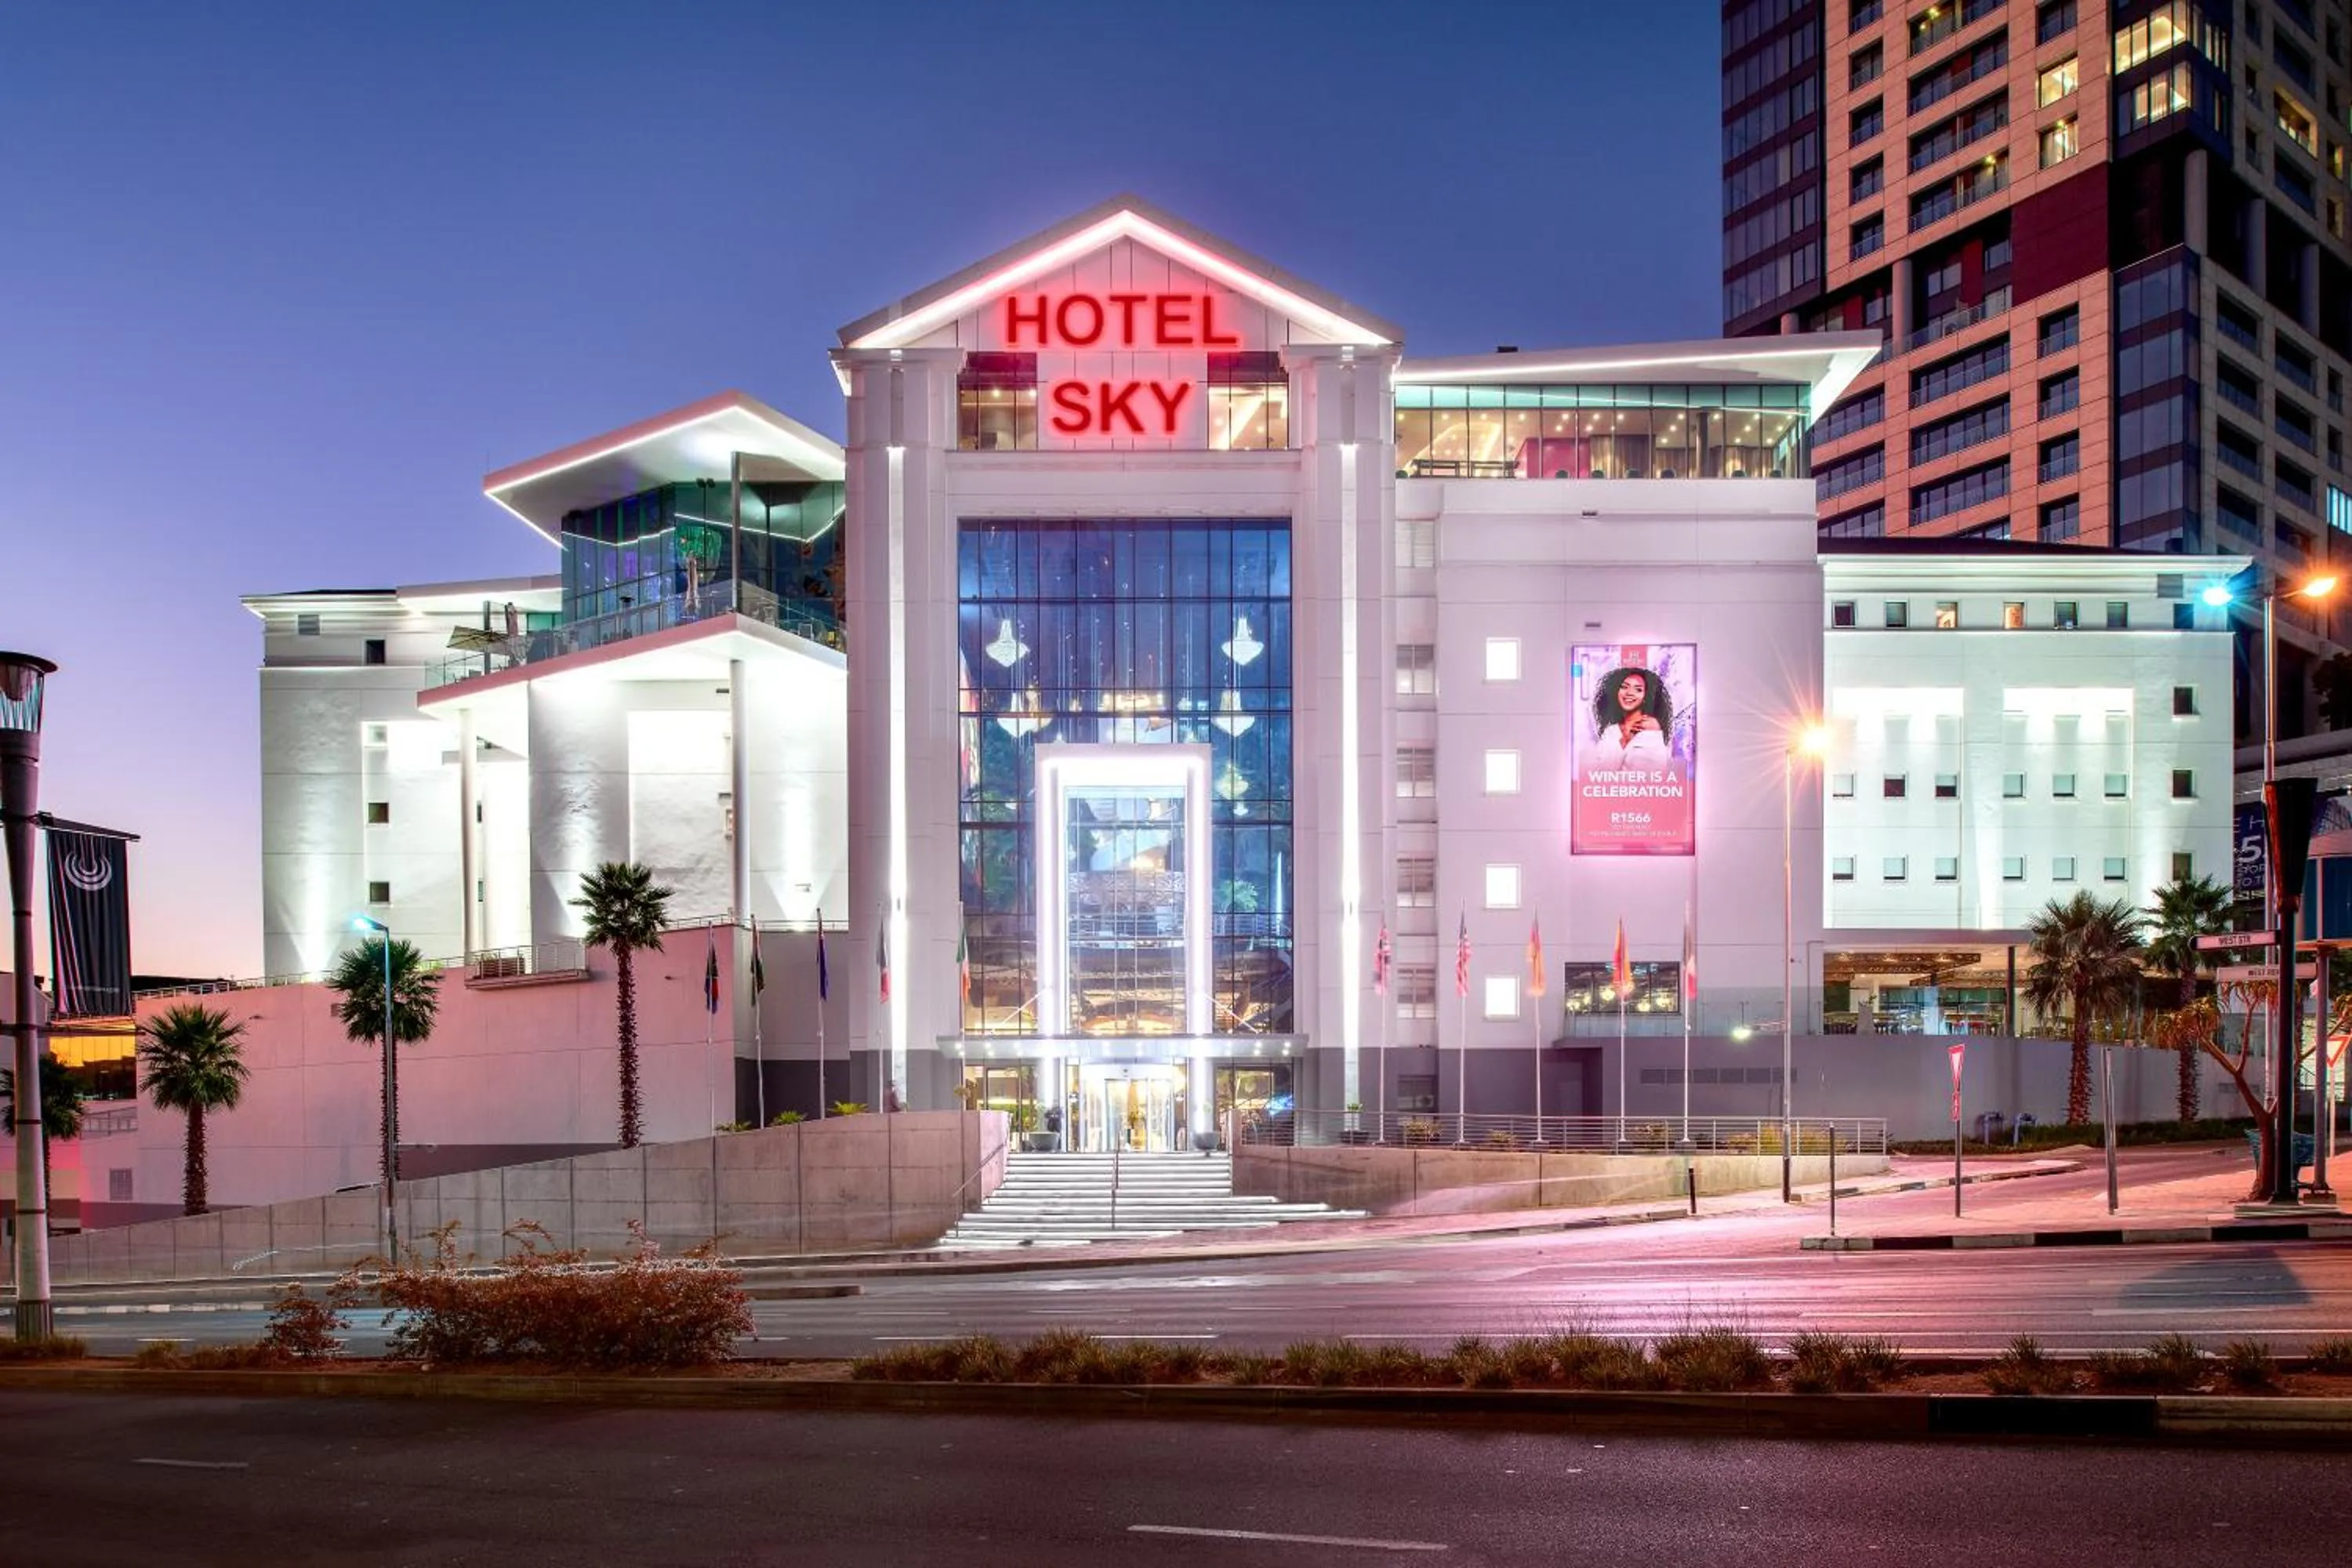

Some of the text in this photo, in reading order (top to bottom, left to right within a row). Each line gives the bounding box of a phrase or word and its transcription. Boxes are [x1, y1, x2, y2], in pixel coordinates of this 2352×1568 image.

[1007, 294, 1237, 345] HOTEL
[1052, 381, 1190, 434] SKY
[1588, 771, 1678, 782] WINTER IS A
[1583, 786, 1682, 797] CELEBRATION
[1611, 812, 1651, 823] R1566
[2219, 936, 2237, 946] WEST
